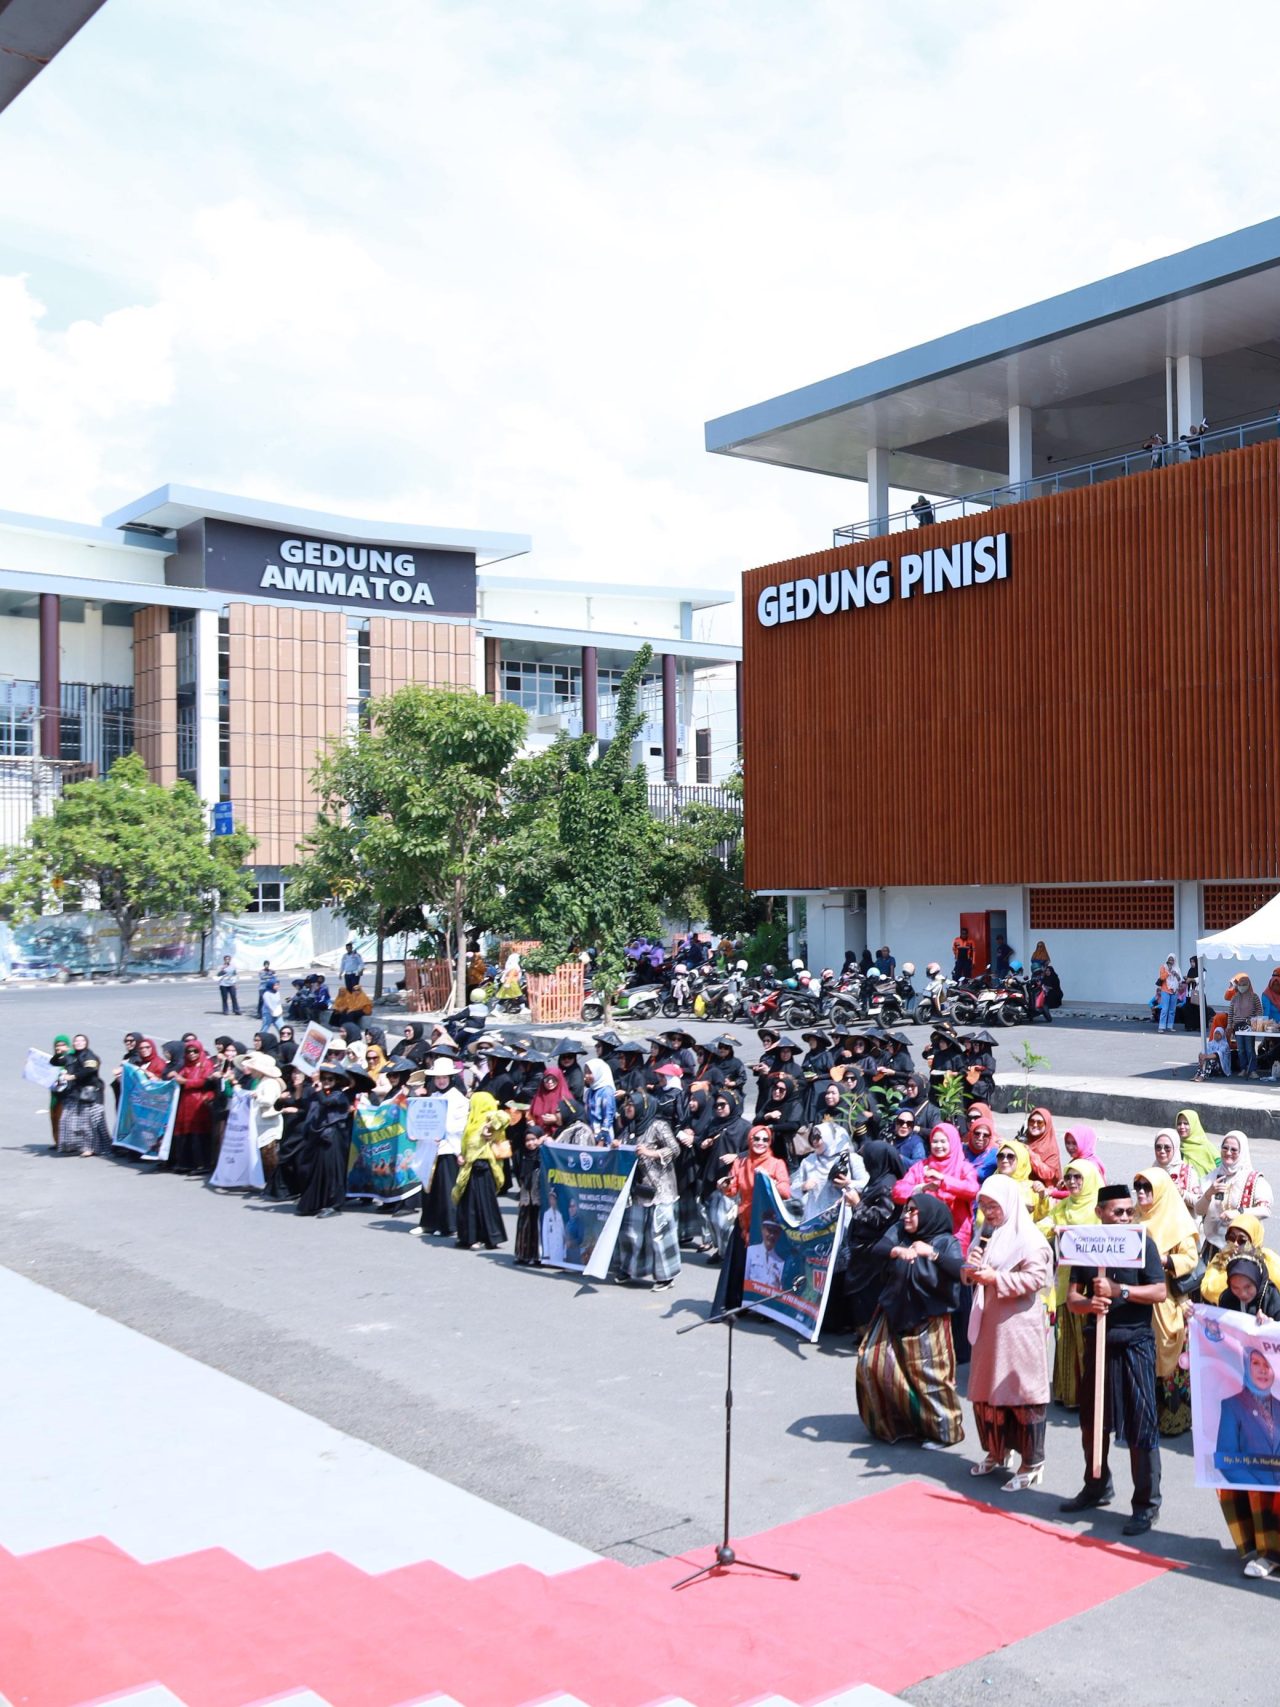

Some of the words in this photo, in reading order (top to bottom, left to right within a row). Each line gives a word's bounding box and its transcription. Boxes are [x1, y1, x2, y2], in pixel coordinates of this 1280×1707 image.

[279, 539, 416, 577] GEDUNG
[260, 565, 435, 606] AMMATOA
[757, 560, 891, 627] GEDUNG
[900, 533, 1008, 599] PINISI
[1075, 1243, 1104, 1253] RILAU
[1106, 1243, 1125, 1253] ALE
